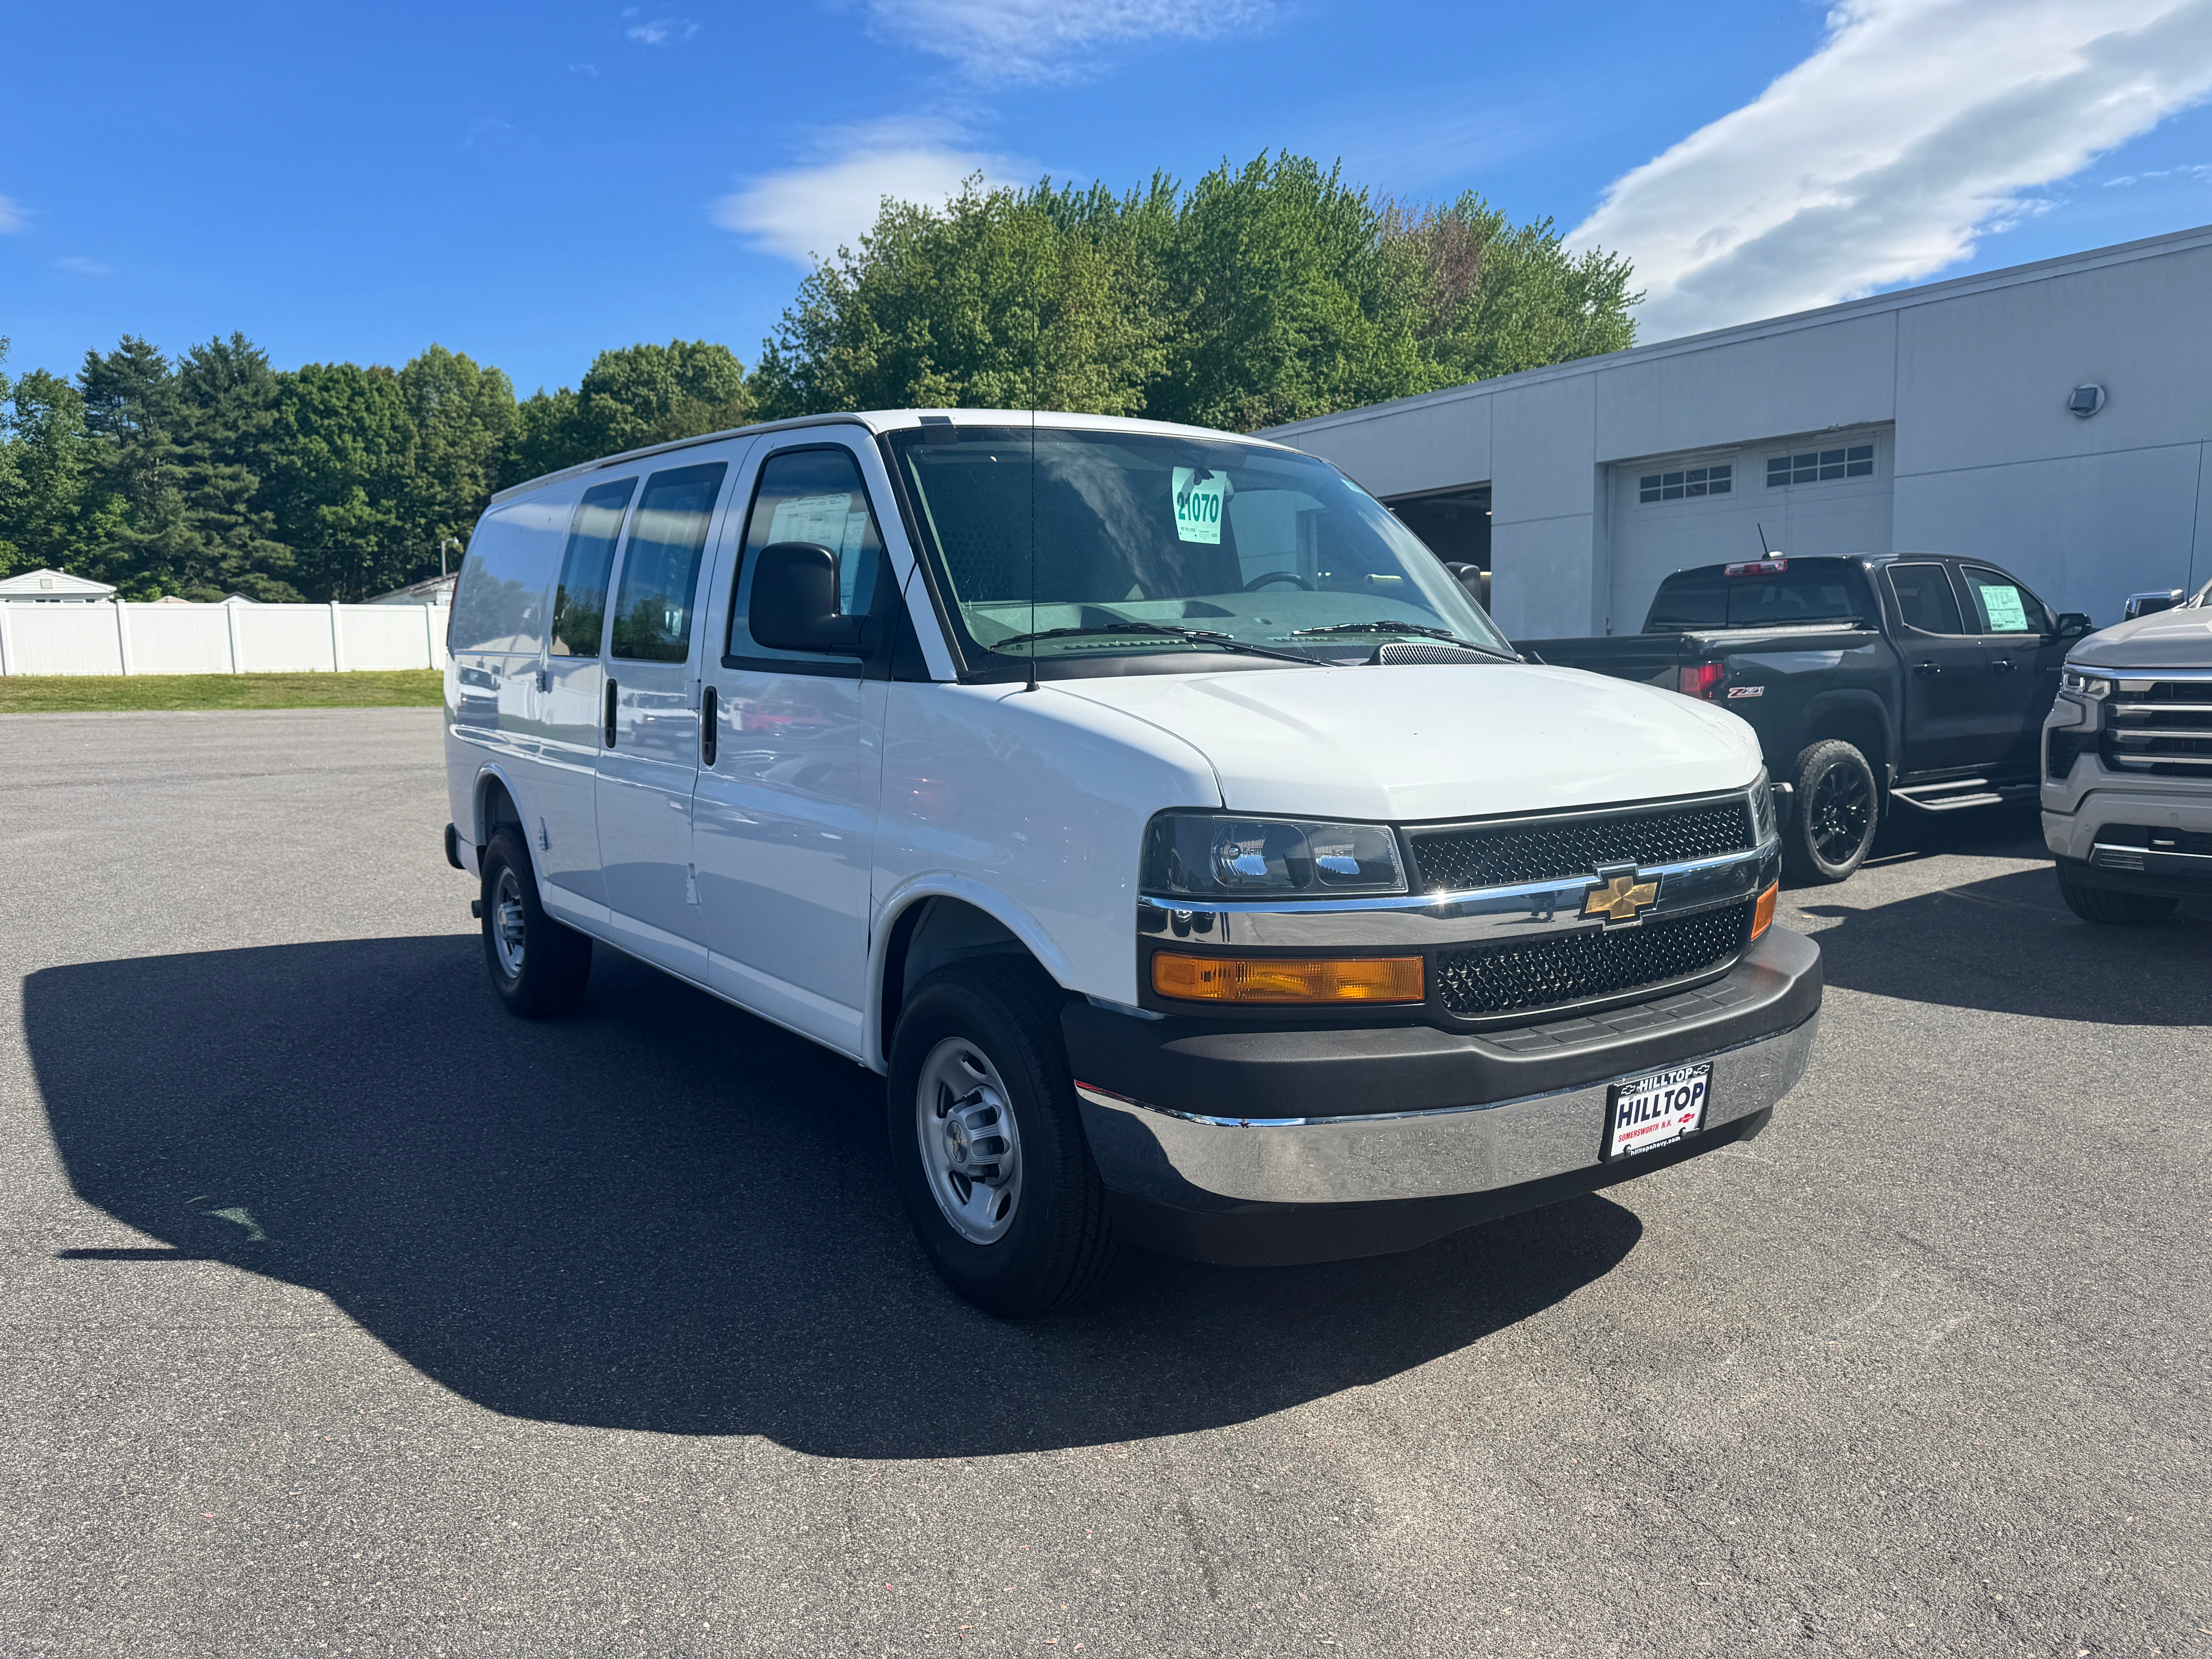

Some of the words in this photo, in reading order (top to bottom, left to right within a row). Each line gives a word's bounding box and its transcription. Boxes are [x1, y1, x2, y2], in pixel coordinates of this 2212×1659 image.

[1177, 492, 1219, 523] 21070
[1728, 686, 1764, 699] Z71
[1639, 1067, 1693, 1091] HILLTOP
[1617, 1082, 1704, 1129] HILLTOP
[1618, 1123, 1659, 1142] SOMERSWORTH
[1661, 1120, 1672, 1129] N.H.
[1630, 1136, 1680, 1156] hilltopchevy.com
